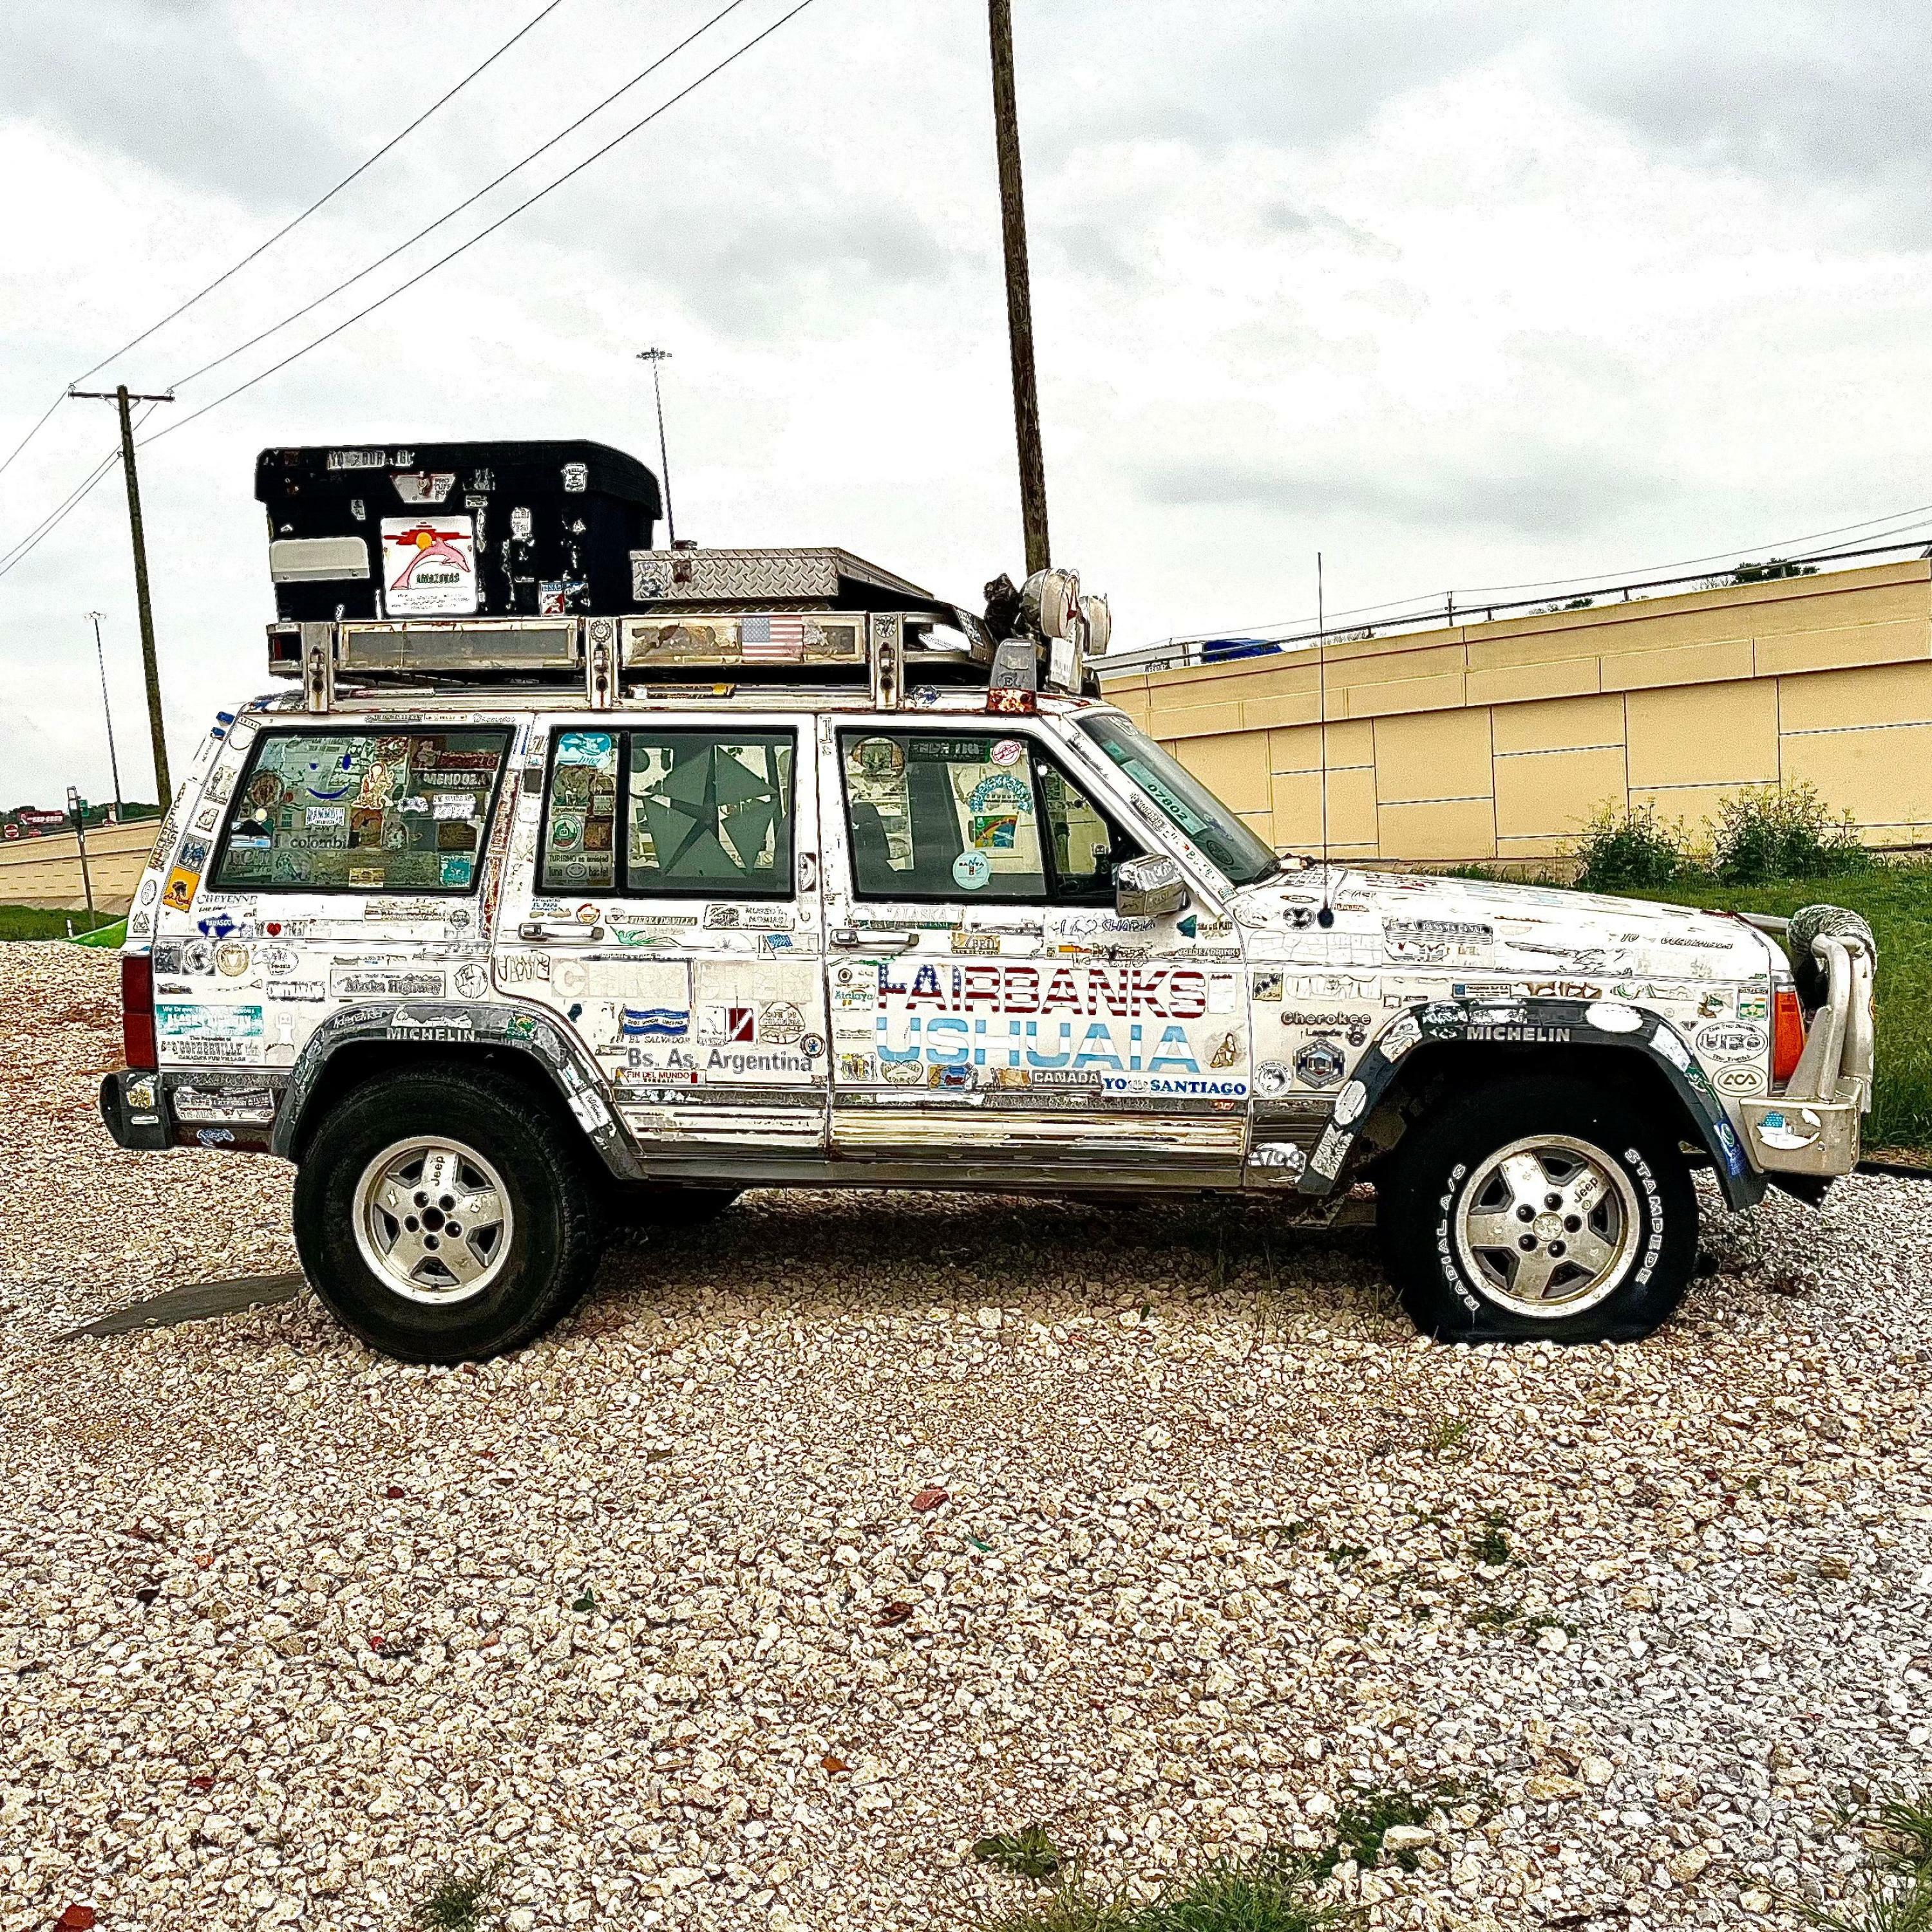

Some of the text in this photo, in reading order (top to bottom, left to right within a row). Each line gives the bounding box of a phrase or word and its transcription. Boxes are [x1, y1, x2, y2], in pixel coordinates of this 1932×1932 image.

[423, 772, 486, 785] MENDOZA
[1148, 783, 1188, 821] 07802
[290, 835, 348, 849] colombi
[549, 855, 577, 863] TURISMO
[1423, 923, 1455, 932] PANAMA
[344, 980, 386, 993] Alaska
[878, 964, 1206, 1019] FAIRBANKS
[835, 990, 873, 1001] Atalaya
[1281, 1010, 1371, 1025] Cherokee
[386, 1027, 475, 1041] MICHELIN
[1466, 1027, 1570, 1042] MICHELIN
[876, 1017, 1200, 1074] USHUAIA
[1700, 1034, 1766, 1050] UFO
[629, 1048, 813, 1074] Bs. As. Argentina
[1034, 1072, 1100, 1085] CANADA
[1723, 1074, 1757, 1085] ACA
[1104, 1078, 1247, 1095] YO SANTIAGO
[431, 1155, 444, 1187] Jeep
[1574, 1176, 1598, 1204] Jeep
[1624, 1148, 1665, 1285] STAMPEDE
[1437, 1163, 1481, 1312] RADIAL A/S
